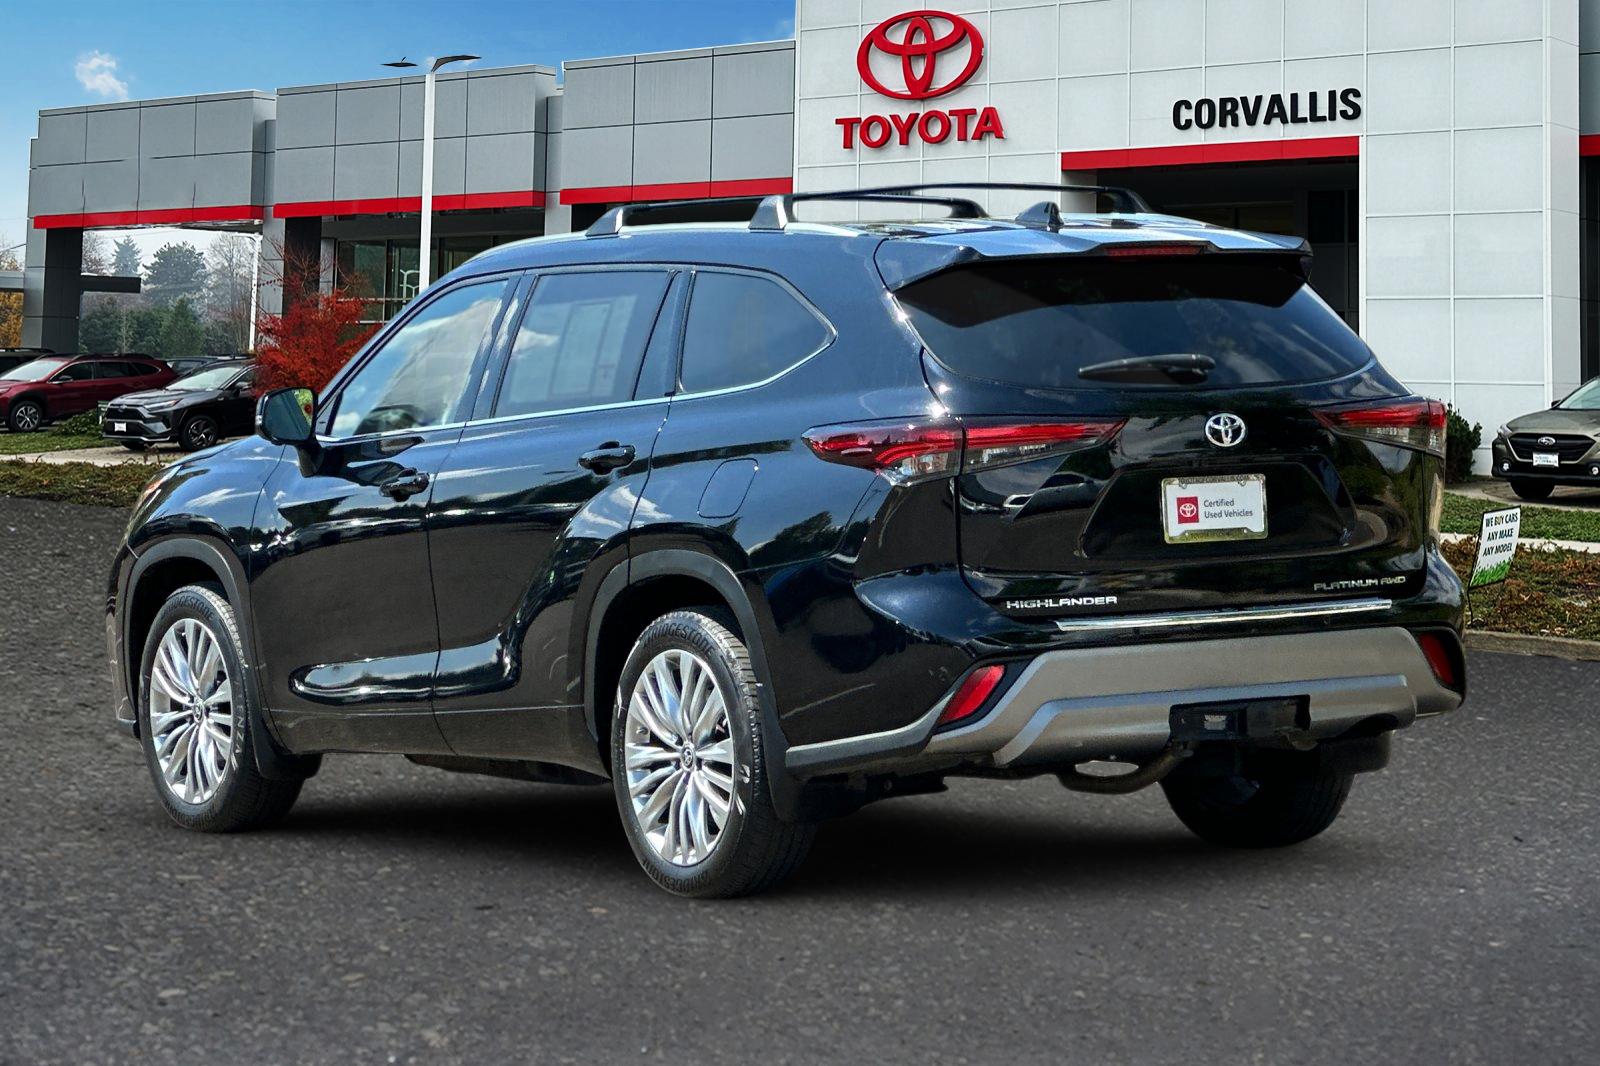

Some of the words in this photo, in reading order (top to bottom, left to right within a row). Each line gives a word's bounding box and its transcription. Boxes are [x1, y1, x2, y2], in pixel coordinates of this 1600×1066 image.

[1172, 87, 1362, 131] CORVALLIS
[835, 106, 1005, 150] TOYOTA
[1203, 498, 1235, 508] Certified
[1204, 510, 1223, 519] Used
[1224, 509, 1253, 518] Vehicles
[1485, 517, 1493, 527] WE
[1494, 515, 1504, 526] BUY
[1505, 513, 1518, 524] CARS
[1486, 530, 1498, 542] ANY
[1498, 528, 1514, 539] MAKE
[1483, 545, 1494, 556] ANY
[1494, 543, 1512, 554] MODEL
[1313, 579, 1379, 591] PLATINUM
[1380, 575, 1407, 585] AWD
[1006, 595, 1118, 609] HIGHLANDER
